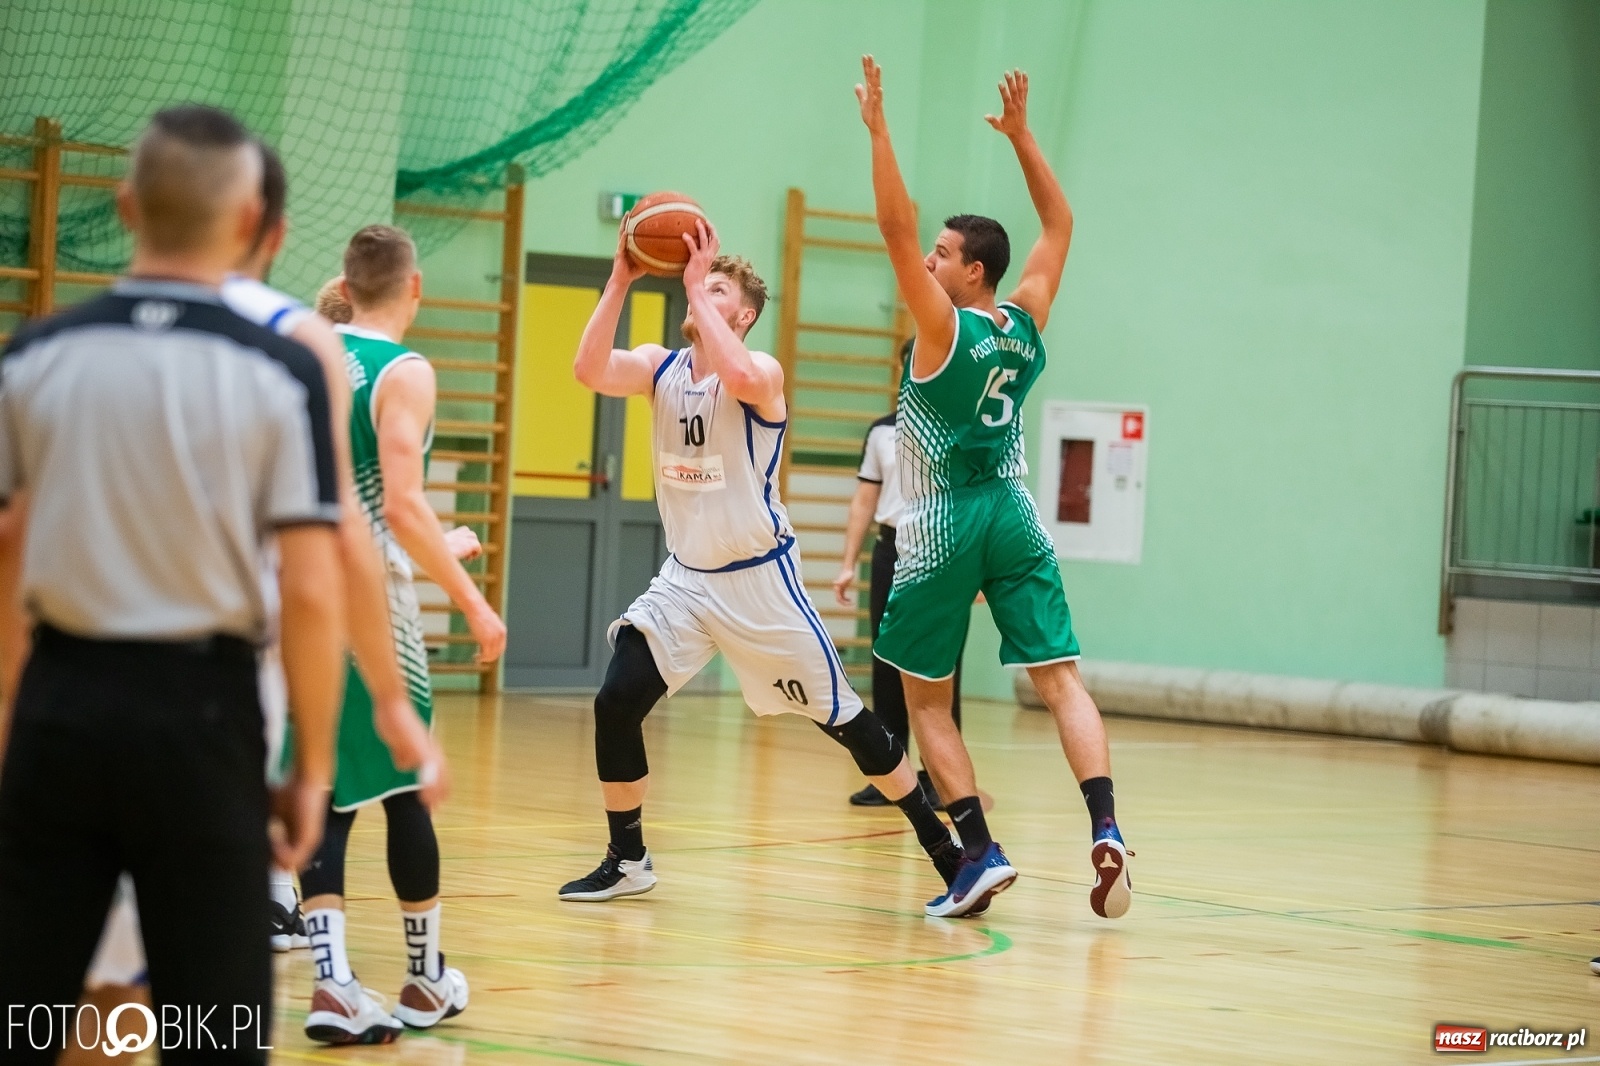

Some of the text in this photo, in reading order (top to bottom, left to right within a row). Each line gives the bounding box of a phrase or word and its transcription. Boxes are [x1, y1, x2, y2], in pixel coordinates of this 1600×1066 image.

[975, 365, 1019, 427] 15
[679, 414, 706, 447] 10
[772, 679, 808, 706] 10
